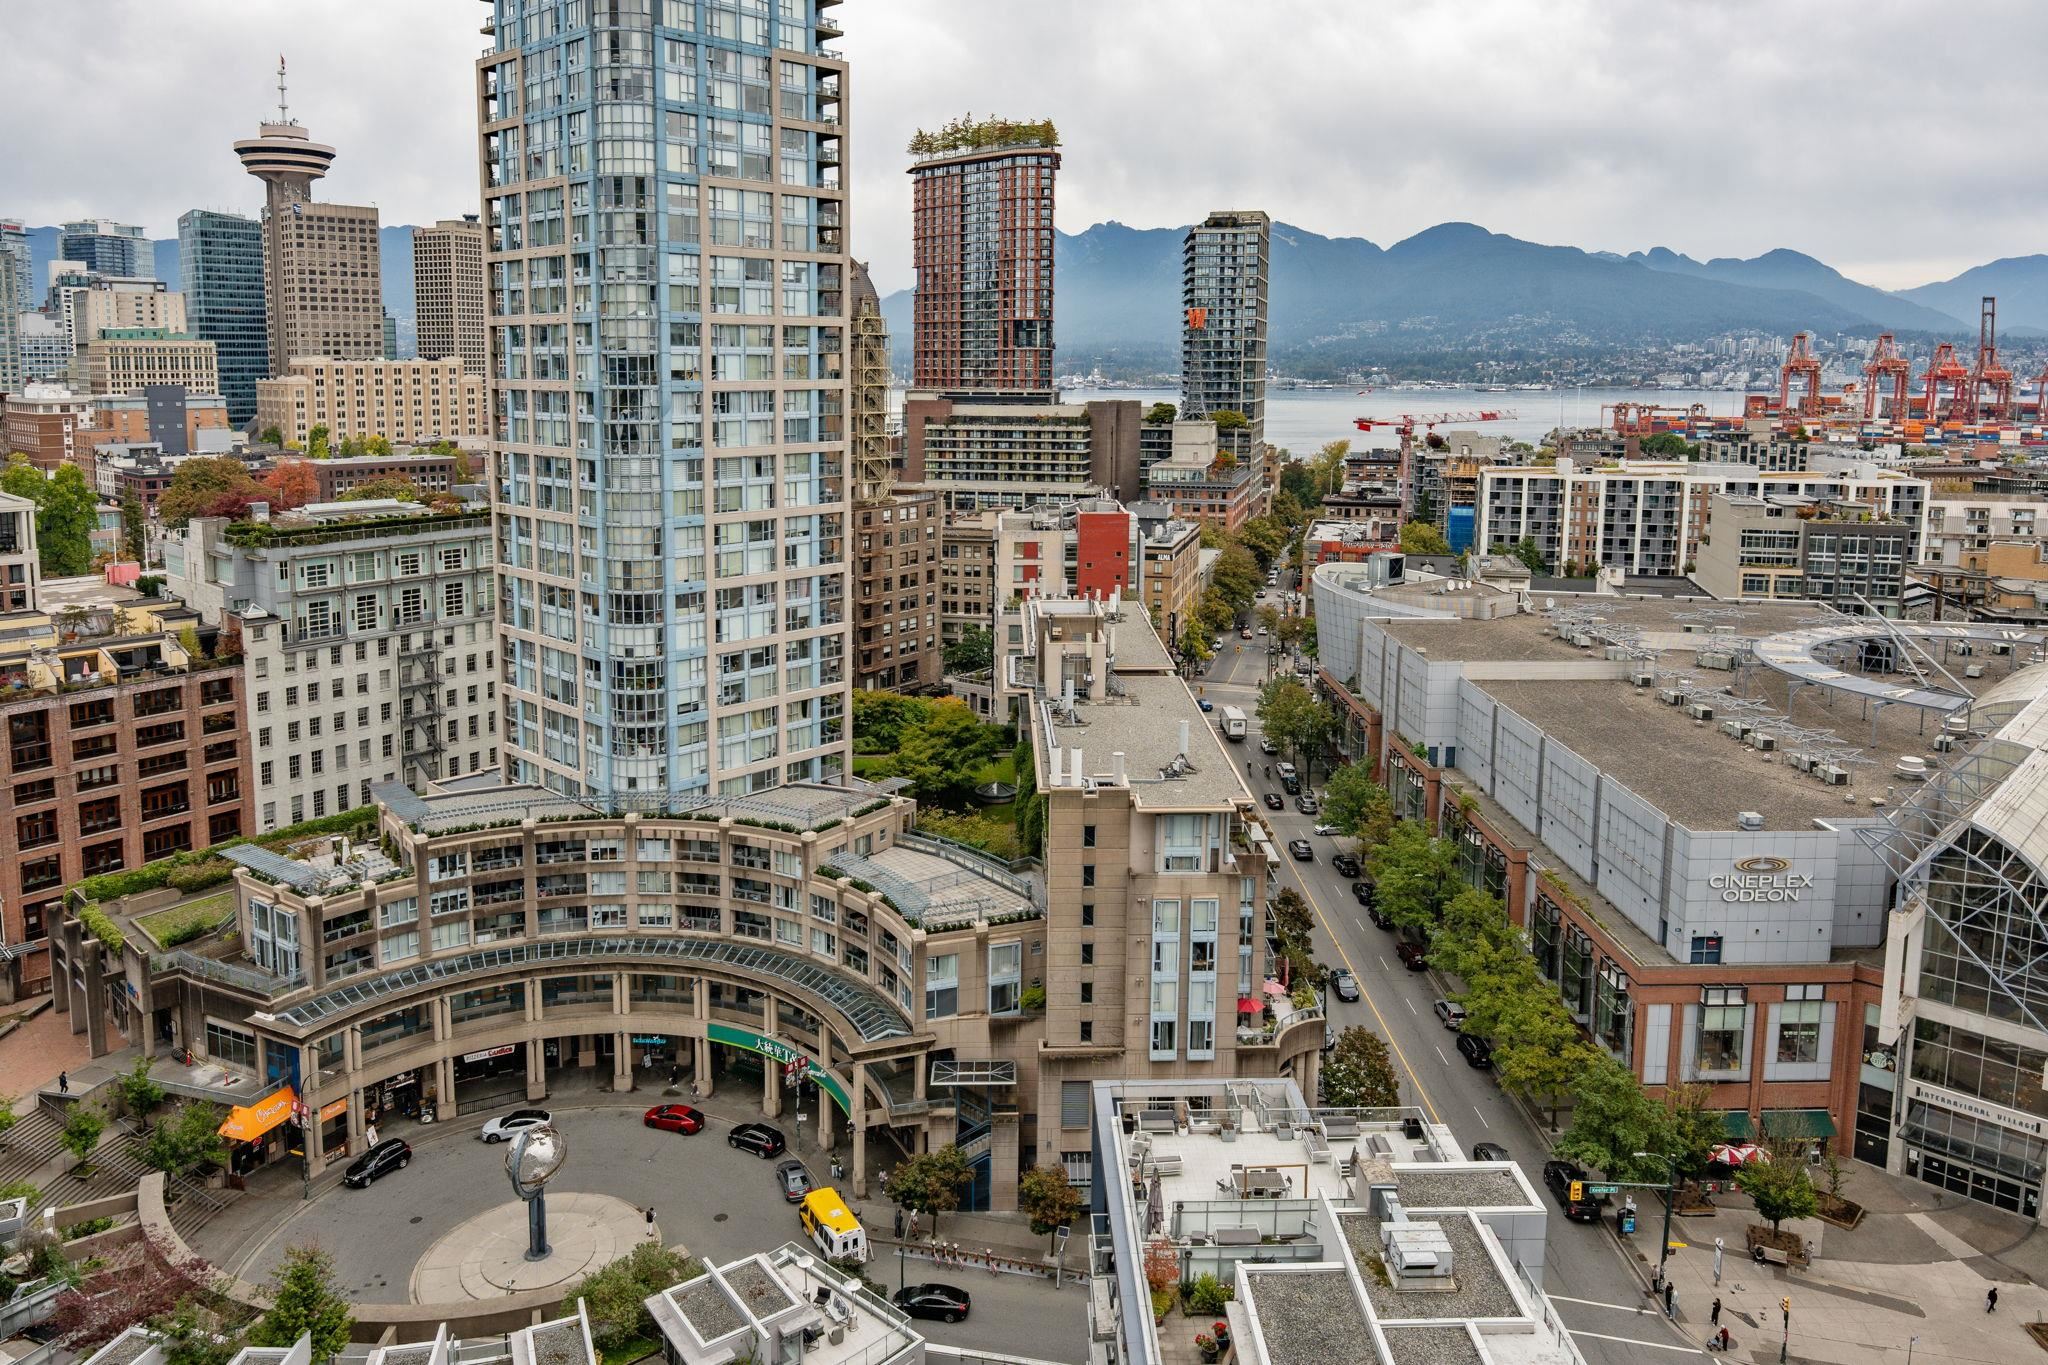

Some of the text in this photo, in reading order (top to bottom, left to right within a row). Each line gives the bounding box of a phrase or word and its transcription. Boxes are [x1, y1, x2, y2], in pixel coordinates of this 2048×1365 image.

[1188, 308, 1206, 328] W
[1709, 874, 1815, 889] CINEPLEX
[1722, 888, 1801, 902] ODEON
